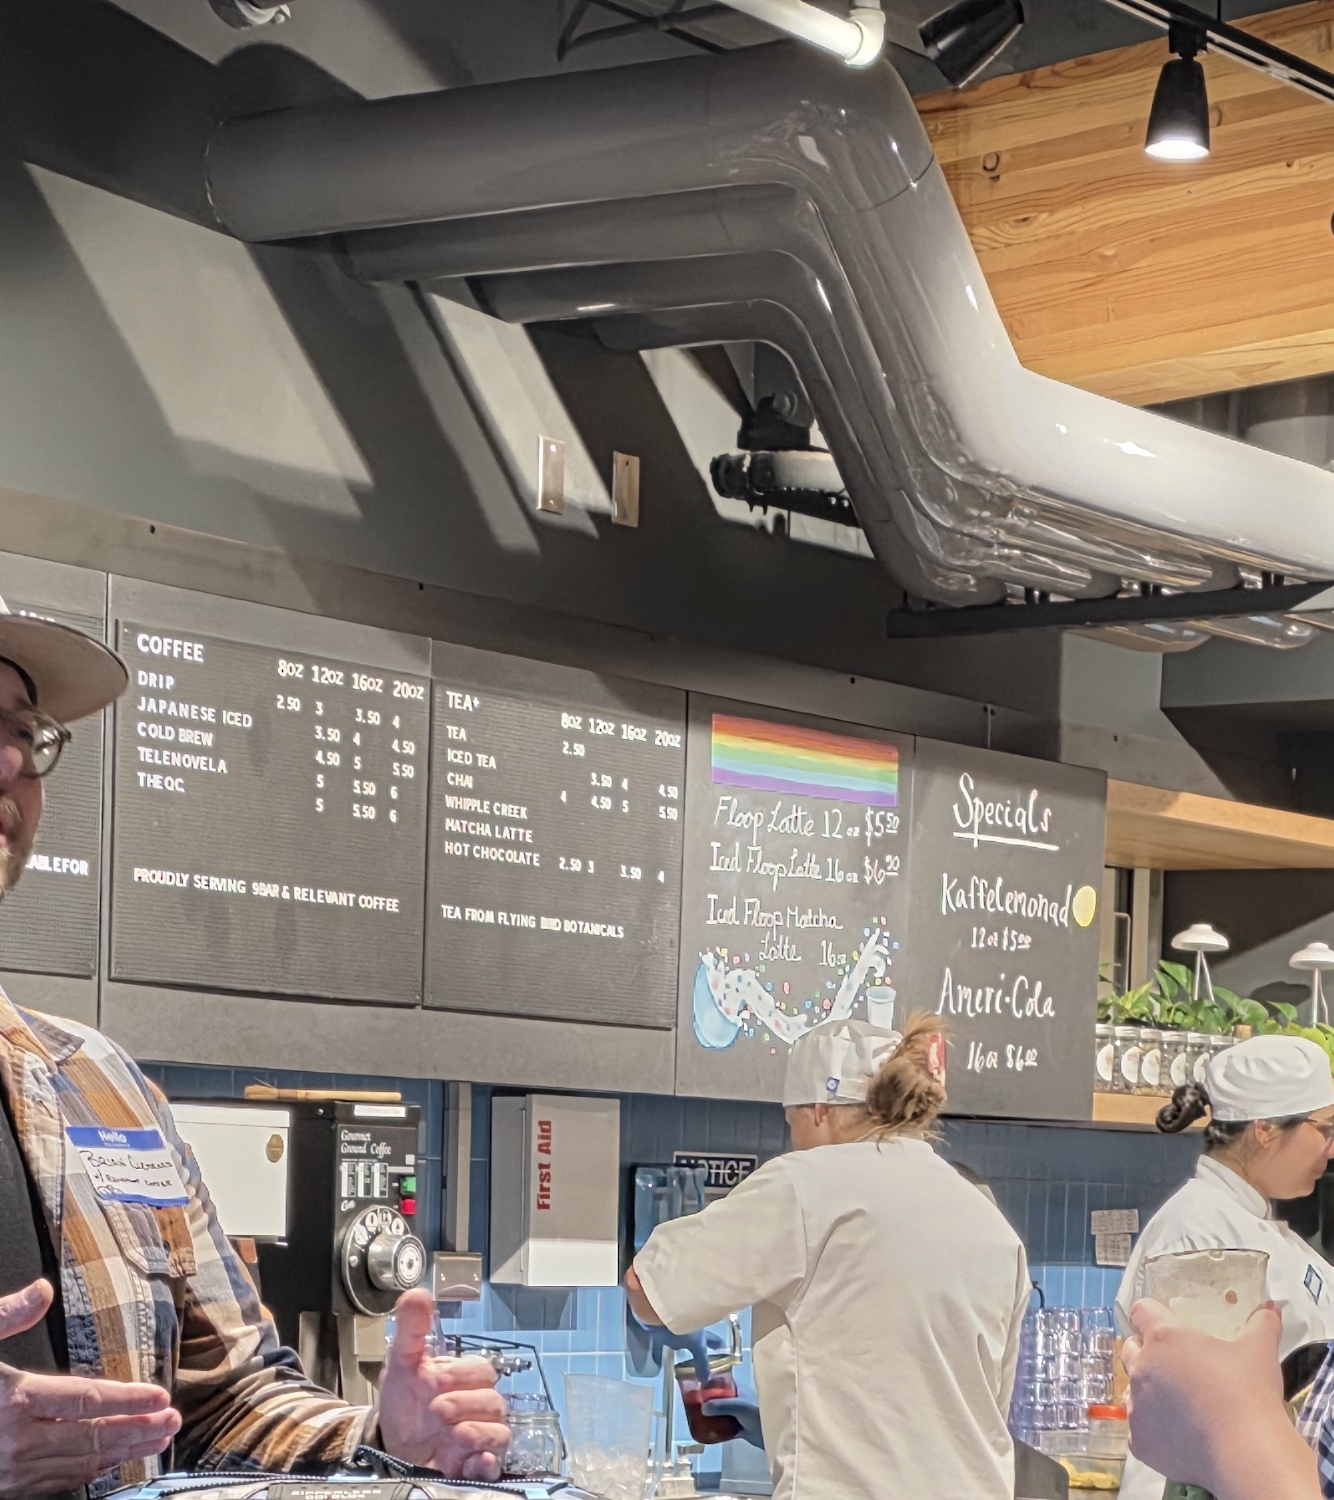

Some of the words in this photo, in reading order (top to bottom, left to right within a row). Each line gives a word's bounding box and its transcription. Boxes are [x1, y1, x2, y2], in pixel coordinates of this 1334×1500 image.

[137, 633, 204, 662] COFFEE
[138, 670, 175, 690] DRIP
[278, 659, 304, 678] 8OZ
[312, 665, 344, 686] 12OZ
[352, 673, 383, 693] 16OZ
[393, 680, 424, 700] 20OZ
[137, 696, 216, 723] JAPANESE
[222, 710, 253, 728] ICED
[315, 702, 323, 715] 3
[356, 709, 381, 726] 3.50
[392, 716, 400, 729] 4
[137, 721, 175, 741] COLD
[178, 727, 214, 747] BREW
[315, 726, 341, 743] 3.50
[353, 733, 361, 746] 4
[446, 725, 467, 741] TEA
[137, 746, 228, 774] TELENOVELA
[447, 748, 473, 765] ICED
[477, 753, 497, 769] TEA
[390, 786, 398, 800] 6
[447, 772, 473, 789] CHAI
[389, 810, 397, 823] 6
[445, 795, 490, 814] WHIPPLE
[493, 802, 528, 819] CREEK
[714, 796, 763, 839] Floop
[767, 800, 815, 837] Latte
[822, 808, 844, 838] 12
[953, 772, 1052, 848] Specials
[445, 818, 492, 837] MATCHA
[495, 825, 533, 843] LATTE
[445, 841, 470, 857] HOT
[473, 845, 540, 867] CHOCOLATE
[709, 841, 742, 873] Iced
[745, 845, 787, 891] Floop
[787, 849, 822, 880] Latte
[825, 857, 843, 883] 16
[133, 867, 189, 888] PROUDLY
[193, 874, 246, 894] SERVING
[281, 885, 290, 900] &
[293, 886, 356, 908] RELEVANT
[358, 894, 400, 913] COFFEE
[441, 904, 462, 920] TEA
[465, 907, 495, 923] FROM
[497, 912, 536, 928] FLYING
[706, 894, 740, 926] Iced
[743, 898, 783, 940] Floop
[786, 907, 843, 930] Matcha
[971, 927, 986, 948] 12
[759, 935, 802, 962] Latte
[819, 940, 836, 967] 16
[967, 1041, 985, 1073] 16
[341, 1130, 371, 1141] Gourmet
[537, 1120, 552, 1155] Aid
[341, 1142, 367, 1154] Ground
[370, 1142, 392, 1158] Coffee
[537, 1163, 551, 1210] First
